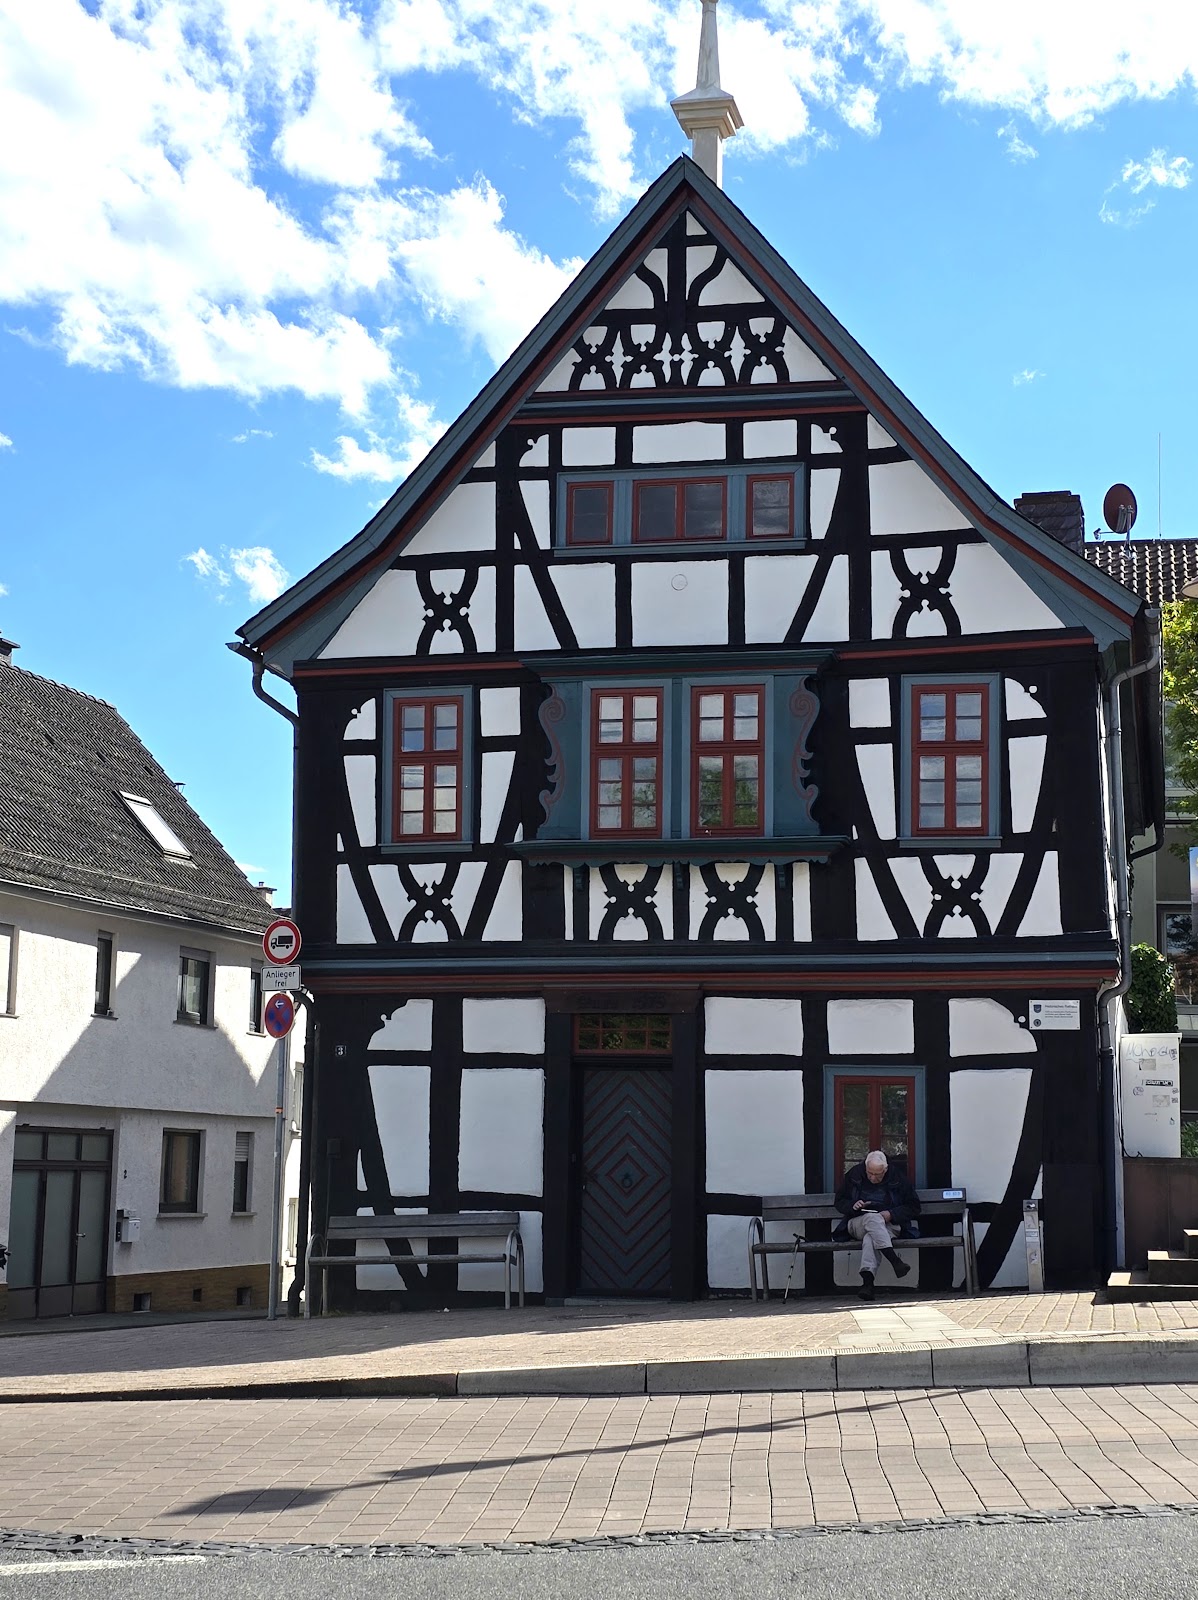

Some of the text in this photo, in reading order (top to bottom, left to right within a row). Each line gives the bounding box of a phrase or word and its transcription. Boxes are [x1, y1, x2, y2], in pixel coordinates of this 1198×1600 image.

[266, 970, 296, 980] Anlieger
[274, 980, 287, 988] frei
[338, 1046, 344, 1056] 3
